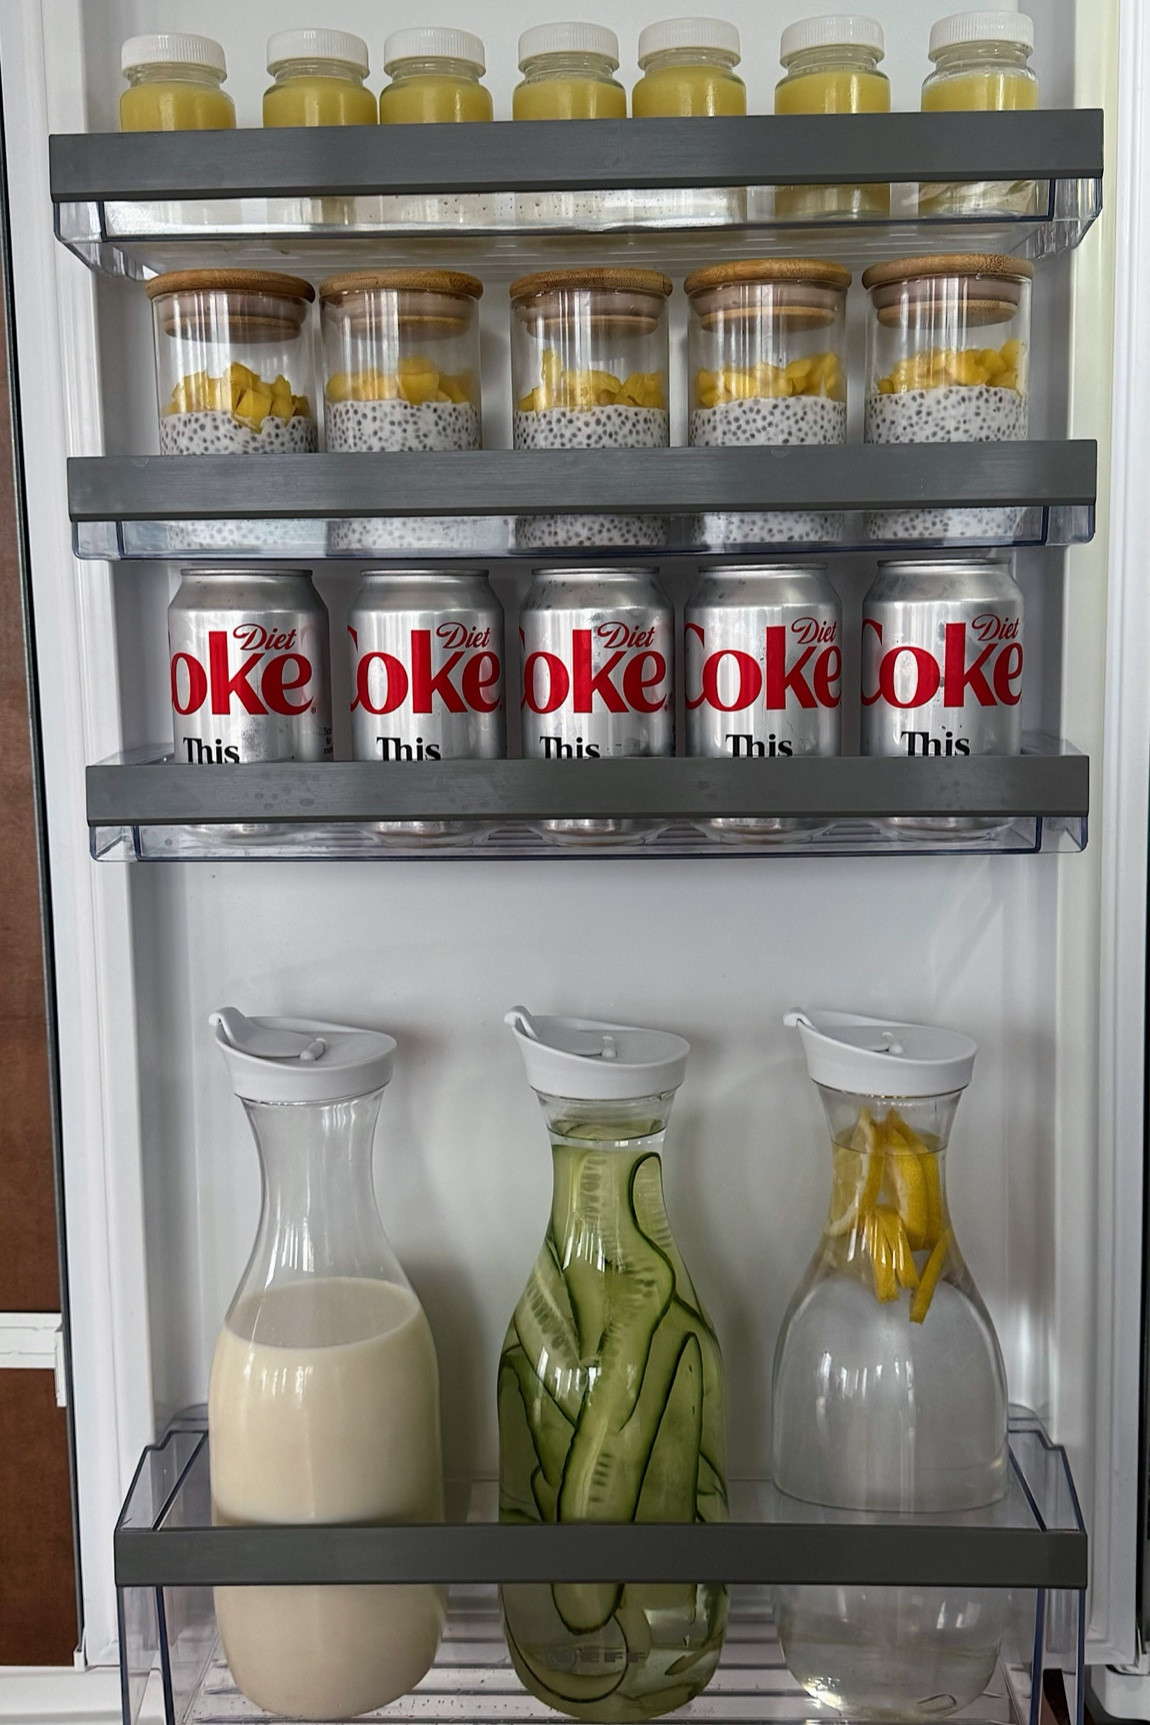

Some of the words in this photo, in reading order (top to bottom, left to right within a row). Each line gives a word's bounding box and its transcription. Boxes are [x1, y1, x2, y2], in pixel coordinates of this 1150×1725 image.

[233, 623, 297, 651] Diet
[436, 622, 491, 650] Diet
[597, 621, 656, 649] Diet
[791, 617, 838, 645] Diet
[972, 614, 1019, 642] Diet
[169, 630, 314, 716] oke
[347, 624, 500, 716] oke
[519, 626, 668, 715] oke
[861, 618, 1024, 709] Coke
[182, 736, 240, 765] This
[376, 736, 442, 762] This
[539, 735, 601, 759] This
[725, 733, 795, 758] This
[900, 730, 971, 757] This
